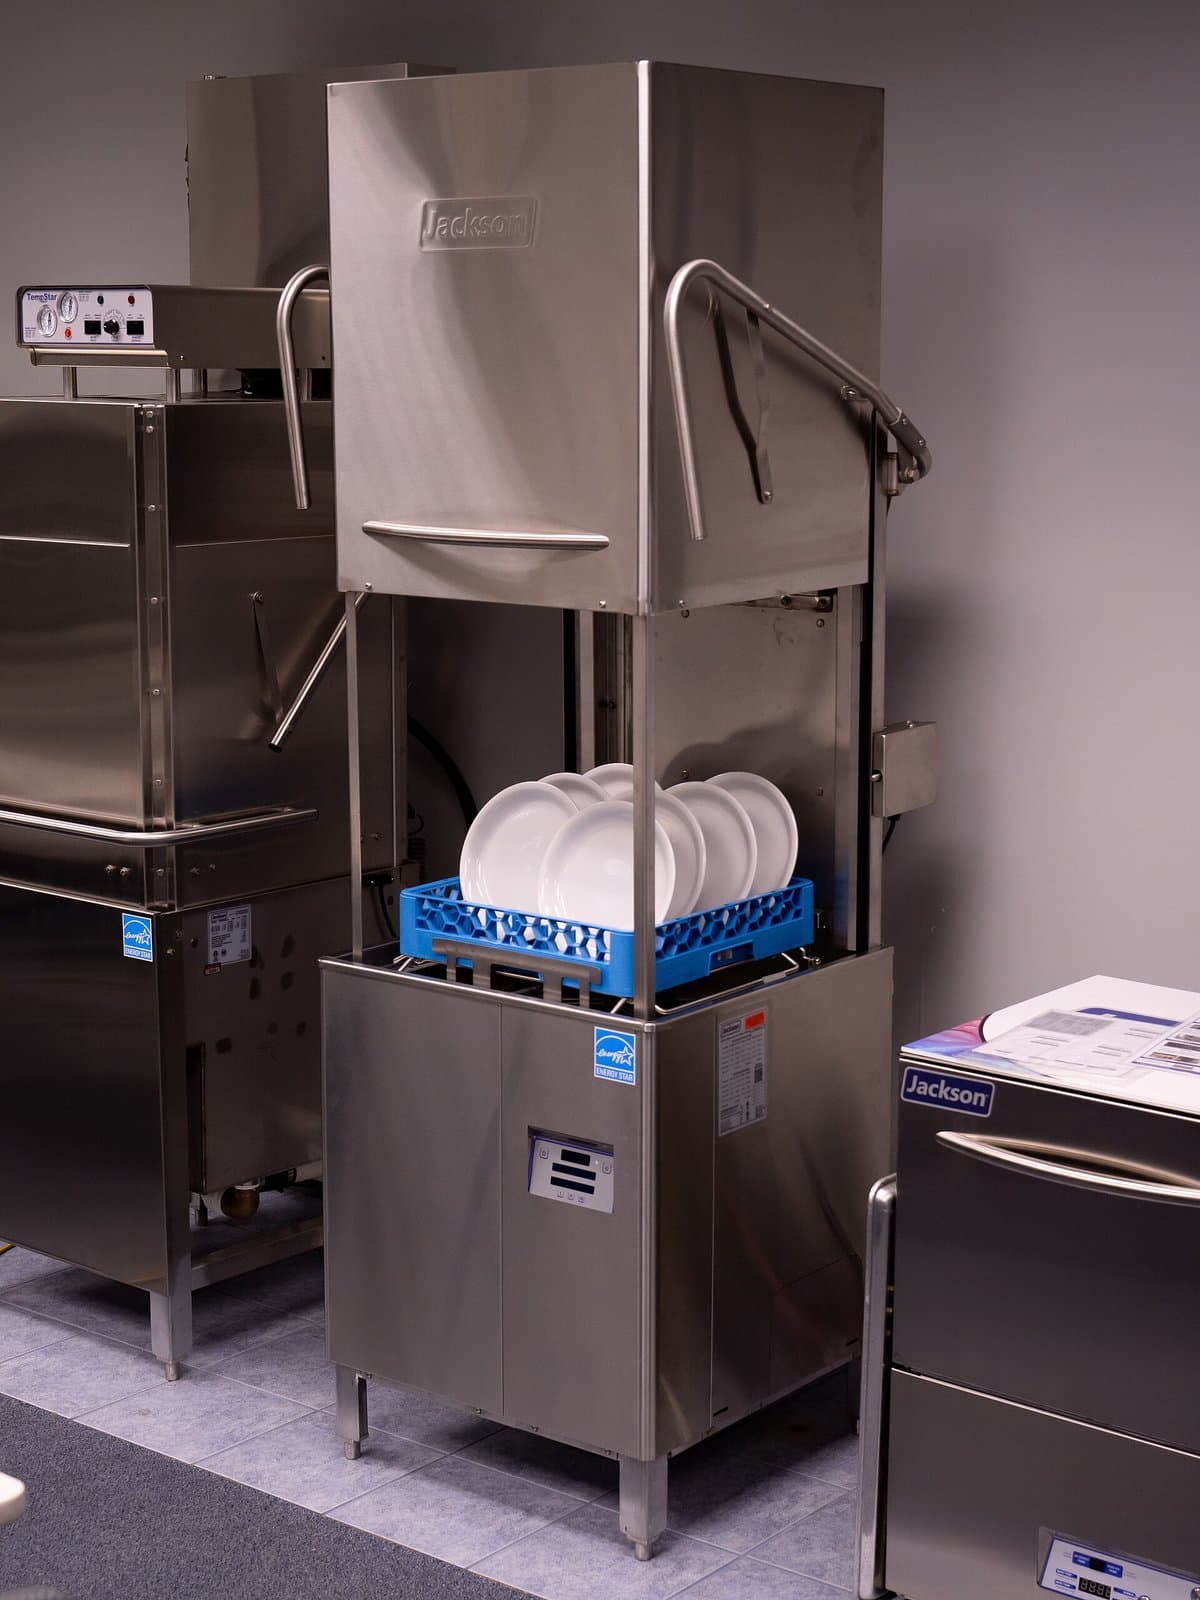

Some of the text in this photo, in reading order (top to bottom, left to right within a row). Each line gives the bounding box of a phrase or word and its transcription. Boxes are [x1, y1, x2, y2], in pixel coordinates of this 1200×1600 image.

[423, 207, 528, 240] Jackson
[27, 293, 57, 303] TempStar
[596, 1066, 633, 1082] ENERGY STAR
[906, 1074, 986, 1107] Jackson
